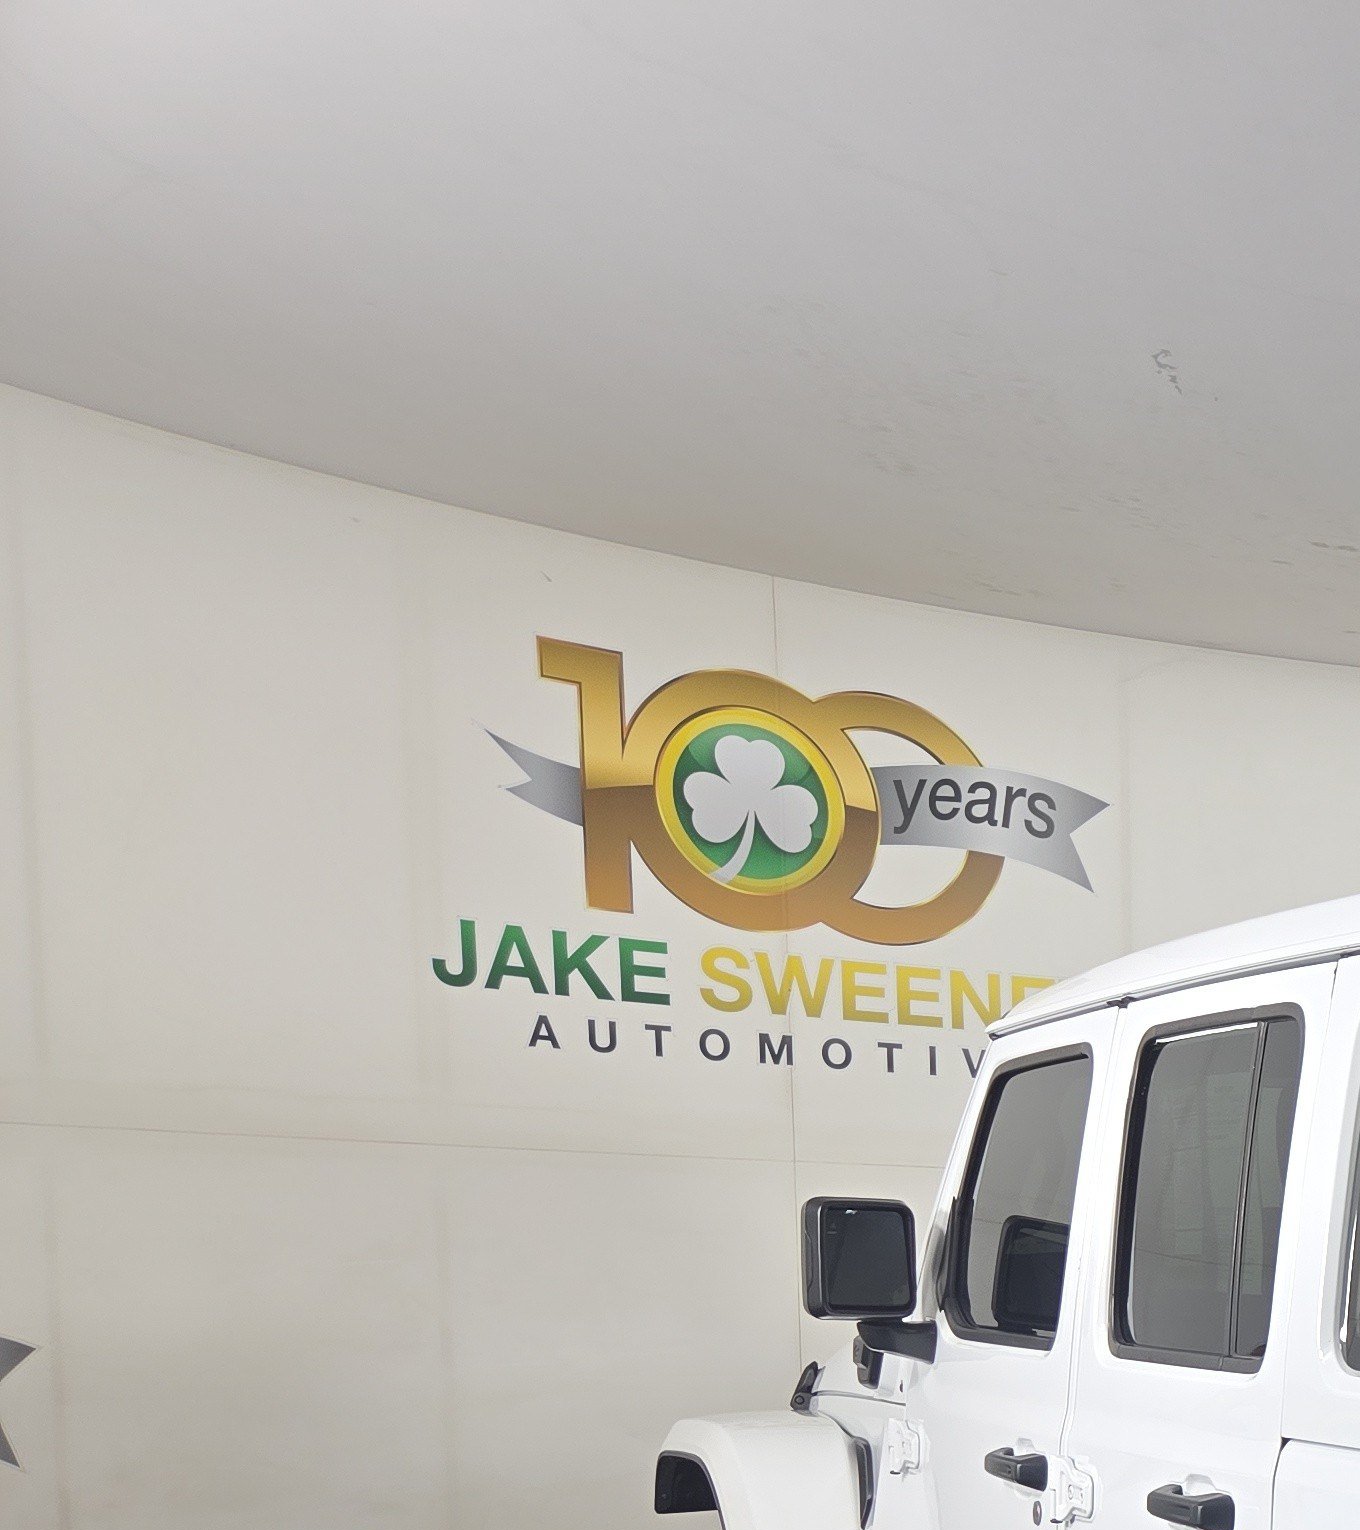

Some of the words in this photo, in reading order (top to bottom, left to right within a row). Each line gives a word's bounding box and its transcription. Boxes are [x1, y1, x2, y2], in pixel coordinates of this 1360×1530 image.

[536, 635, 1005, 946] 100
[893, 777, 1057, 839] years
[431, 917, 671, 1006] JAKE
[699, 946, 1056, 1030] SWEEN
[528, 1014, 986, 1079] AUTOMOTIV
